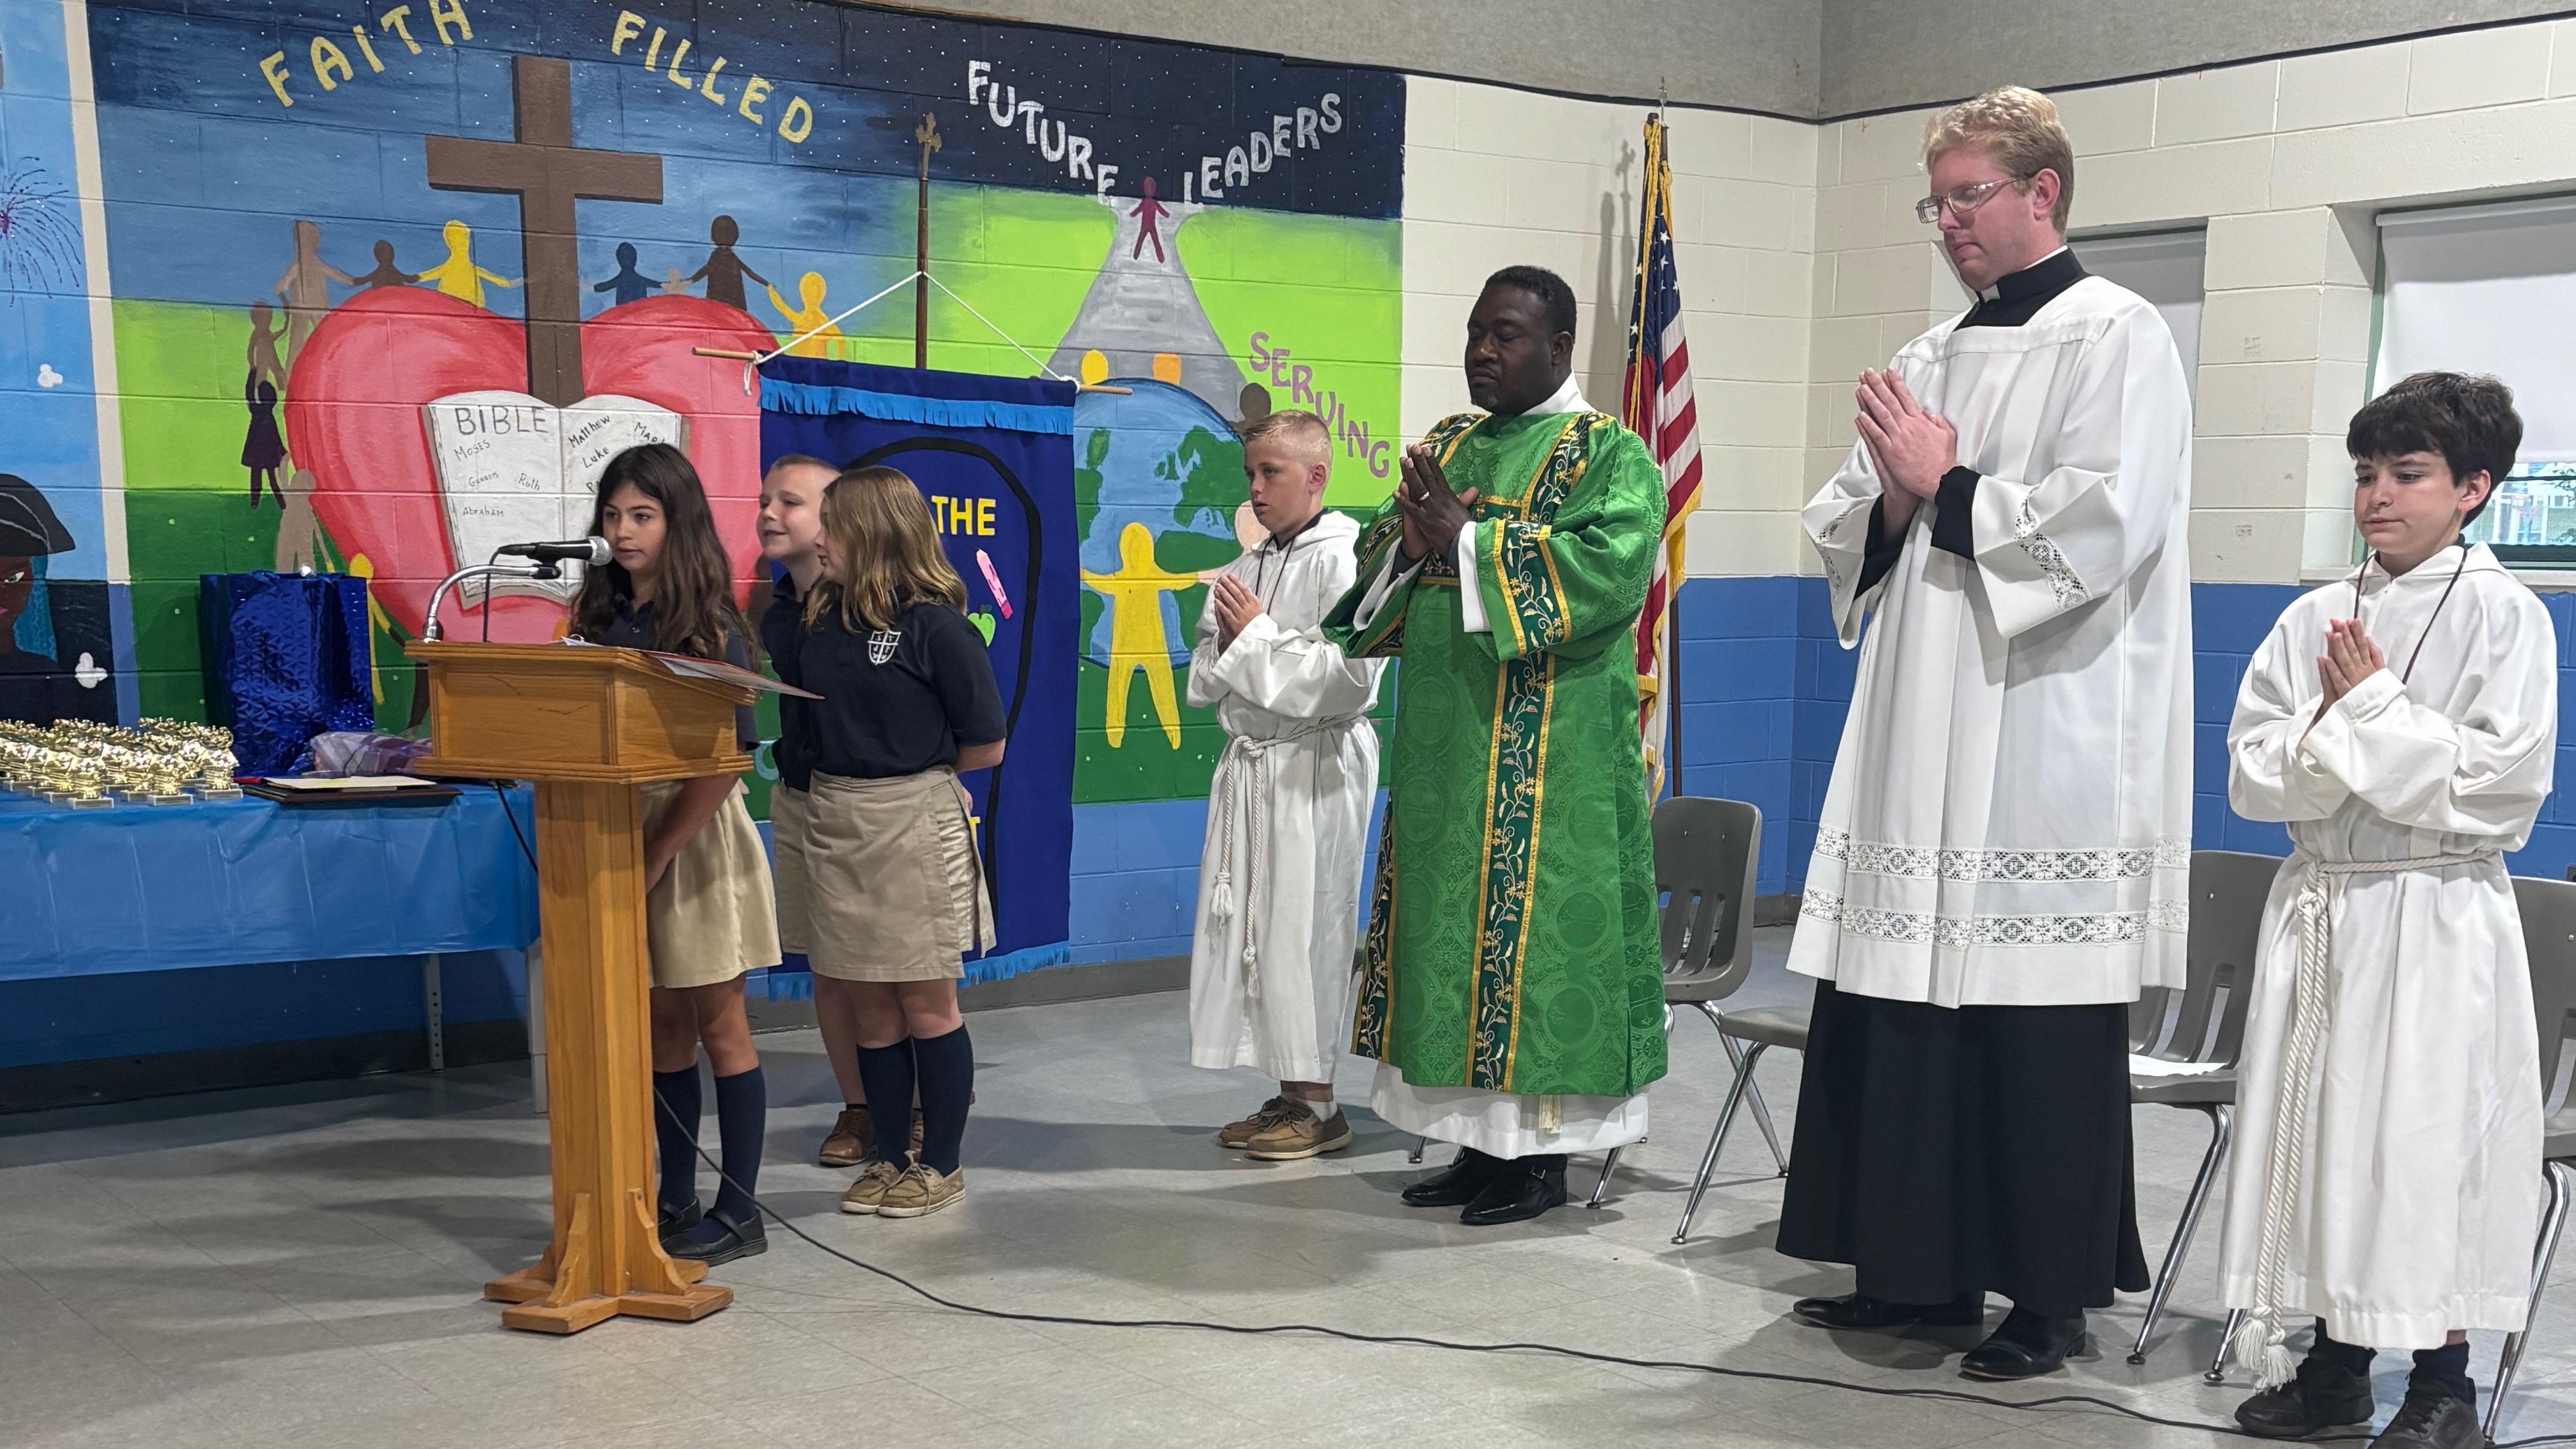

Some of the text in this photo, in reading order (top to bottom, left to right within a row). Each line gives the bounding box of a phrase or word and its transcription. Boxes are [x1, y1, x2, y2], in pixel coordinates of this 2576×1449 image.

[259, 0, 813, 144] FAITH FILLED
[969, 60, 1342, 205] FUTURE LEADERS
[455, 406, 548, 435] BIBLE
[1250, 331, 1390, 478] SERVING
[518, 473, 540, 491] Ruth
[931, 495, 996, 536] THE
